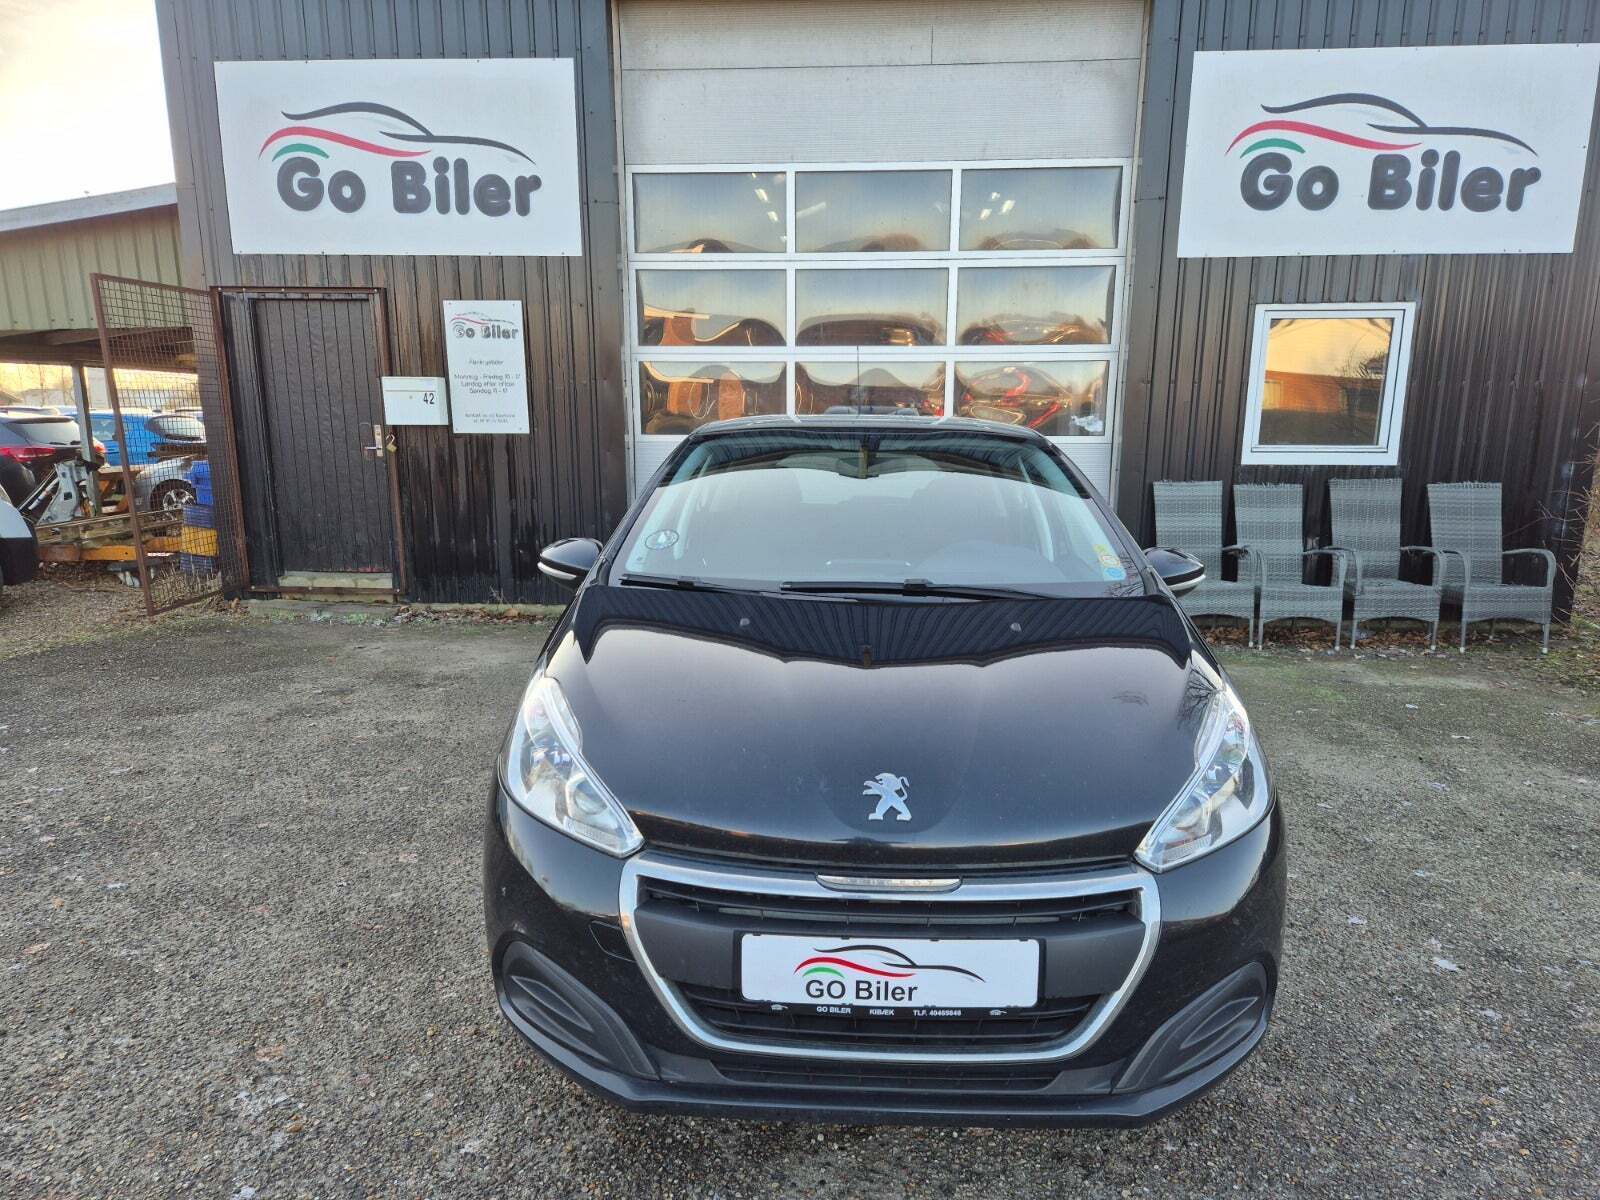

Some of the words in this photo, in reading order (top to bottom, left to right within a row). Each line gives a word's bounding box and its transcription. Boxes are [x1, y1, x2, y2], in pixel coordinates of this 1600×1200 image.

[277, 156, 366, 213] Go
[391, 156, 542, 217] Biler
[1240, 152, 1340, 211] Go
[1367, 149, 1542, 212] Biler
[482, 324, 519, 339] Biler
[423, 392, 435, 405] 42
[805, 979, 846, 1000] GO
[855, 979, 918, 1001] Biler
